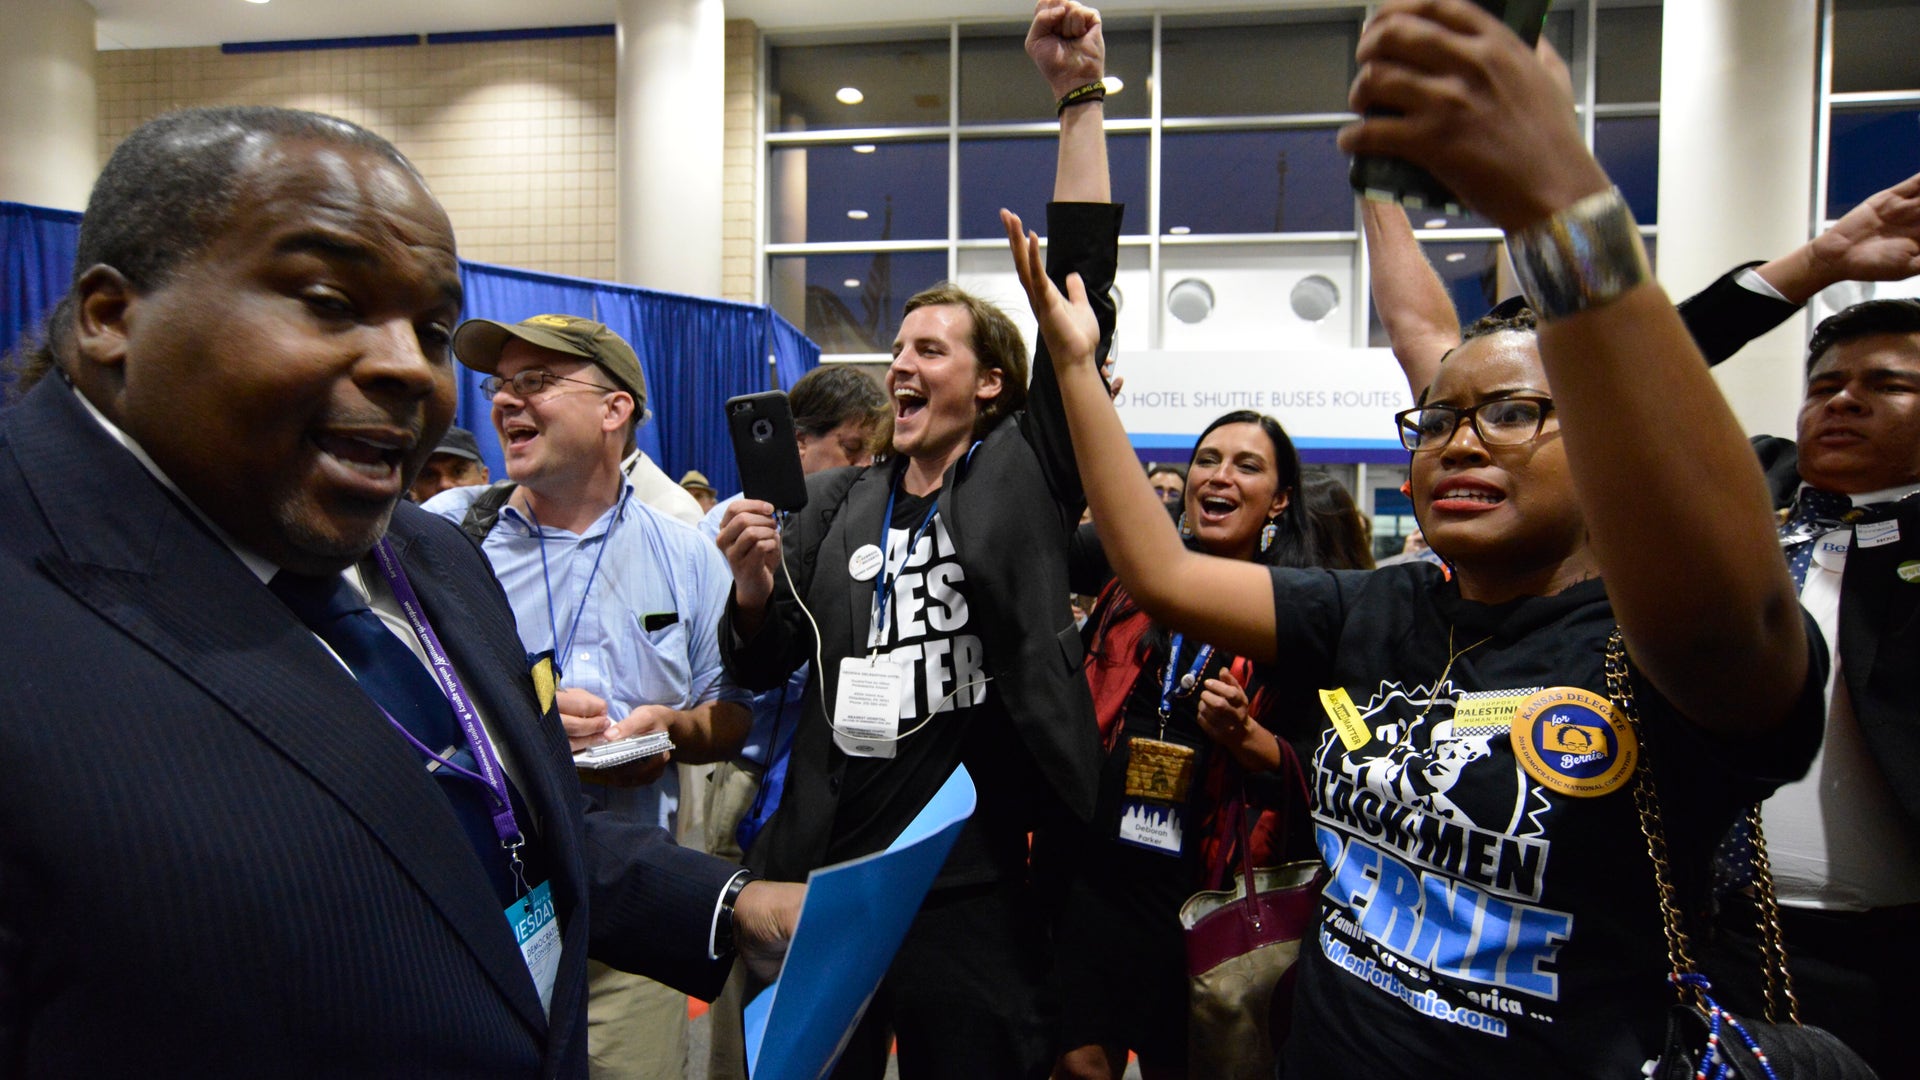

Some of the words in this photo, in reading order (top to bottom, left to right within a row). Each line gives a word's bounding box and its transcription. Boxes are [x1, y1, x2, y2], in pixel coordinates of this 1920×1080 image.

[1132, 392, 1187, 408] HOTEL
[1193, 391, 1264, 408] SHUTTLE
[1271, 391, 1326, 407] BUSES
[1333, 391, 1402, 408] ROUTES
[420, 631, 448, 667] community
[438, 665, 457, 693] umbrella
[450, 691, 467, 714] agency
[464, 721, 479, 742] region
[1522, 693, 1563, 720] KANSAS
[1566, 693, 1626, 731] DELEGATE
[1551, 714, 1570, 727] for
[1342, 716, 1361, 746] MATTER
[1518, 735, 1527, 752] 2016
[1523, 751, 1563, 787] DEMOCRATIC
[1564, 783, 1604, 792] NATIONAL
[1604, 750, 1632, 787] CONVENTION
[1560, 750, 1604, 769] Bernie
[1135, 823, 1168, 838] Deborah
[1138, 834, 1162, 846] Parker
[1417, 813, 1542, 898] MEN
